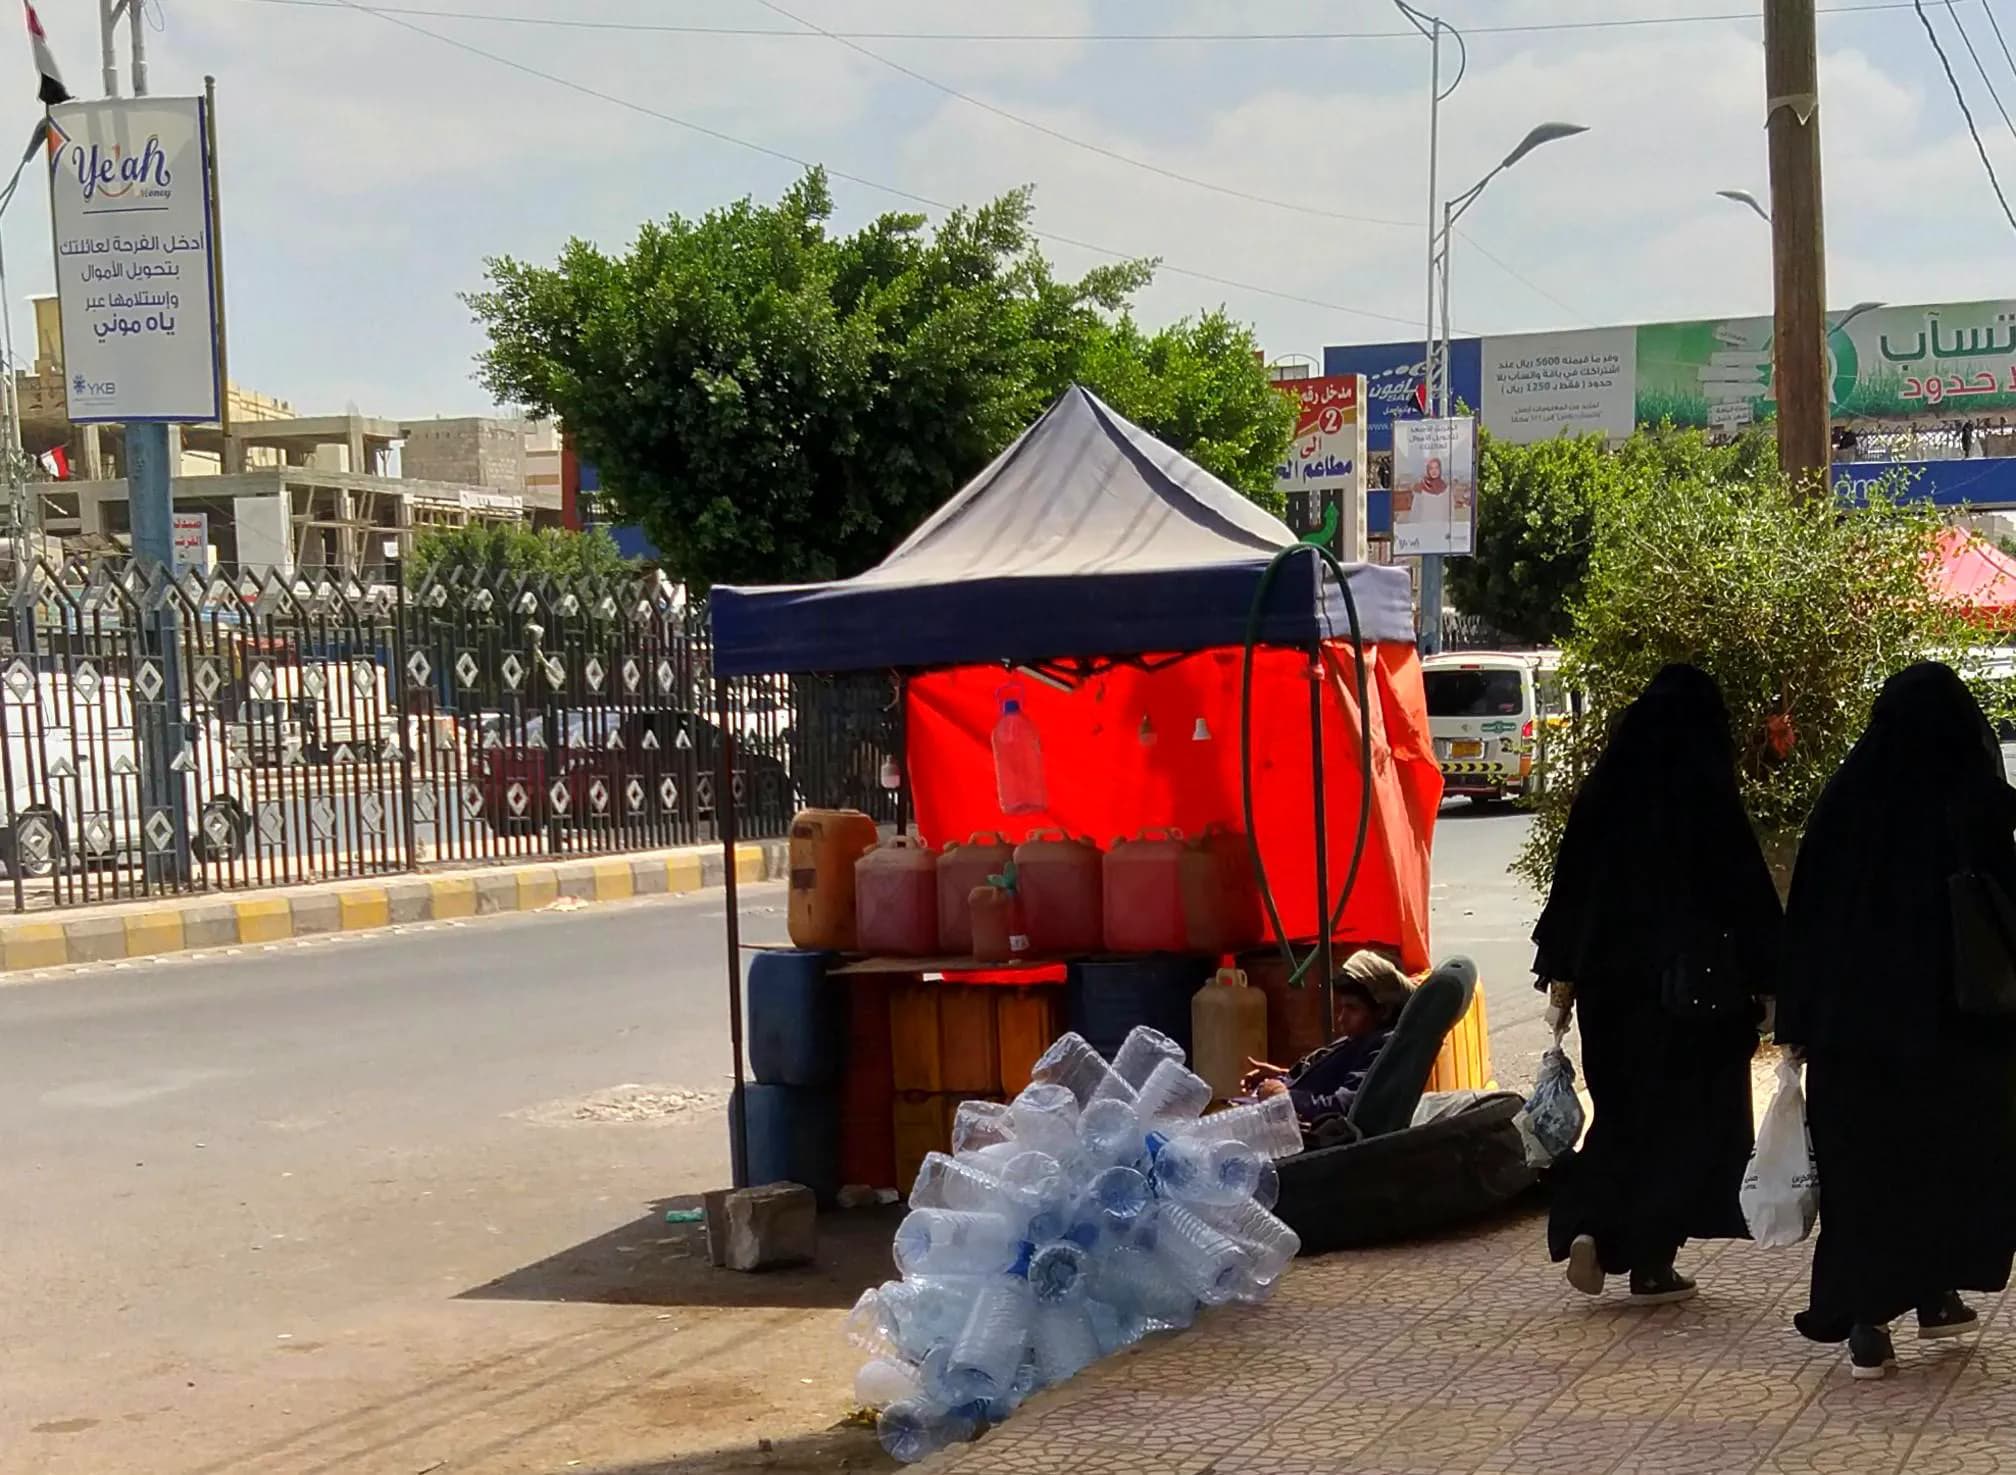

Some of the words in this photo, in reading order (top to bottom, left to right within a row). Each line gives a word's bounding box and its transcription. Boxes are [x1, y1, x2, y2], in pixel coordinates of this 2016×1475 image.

[59, 238, 110, 256] لعائلتك
[112, 234, 159, 255] الفرحة
[163, 231, 205, 254] أدخل
[126, 260, 180, 280] بتحويل
[85, 297, 105, 312] عبر
[93, 313, 142, 343] موني
[145, 311, 175, 336] ياه
[87, 382, 116, 395] YKB
[1320, 383, 1352, 404] مدخل
[1904, 371, 1996, 402] حدود
[1324, 409, 1338, 432] 2
[1304, 454, 1353, 484] مطاعم
